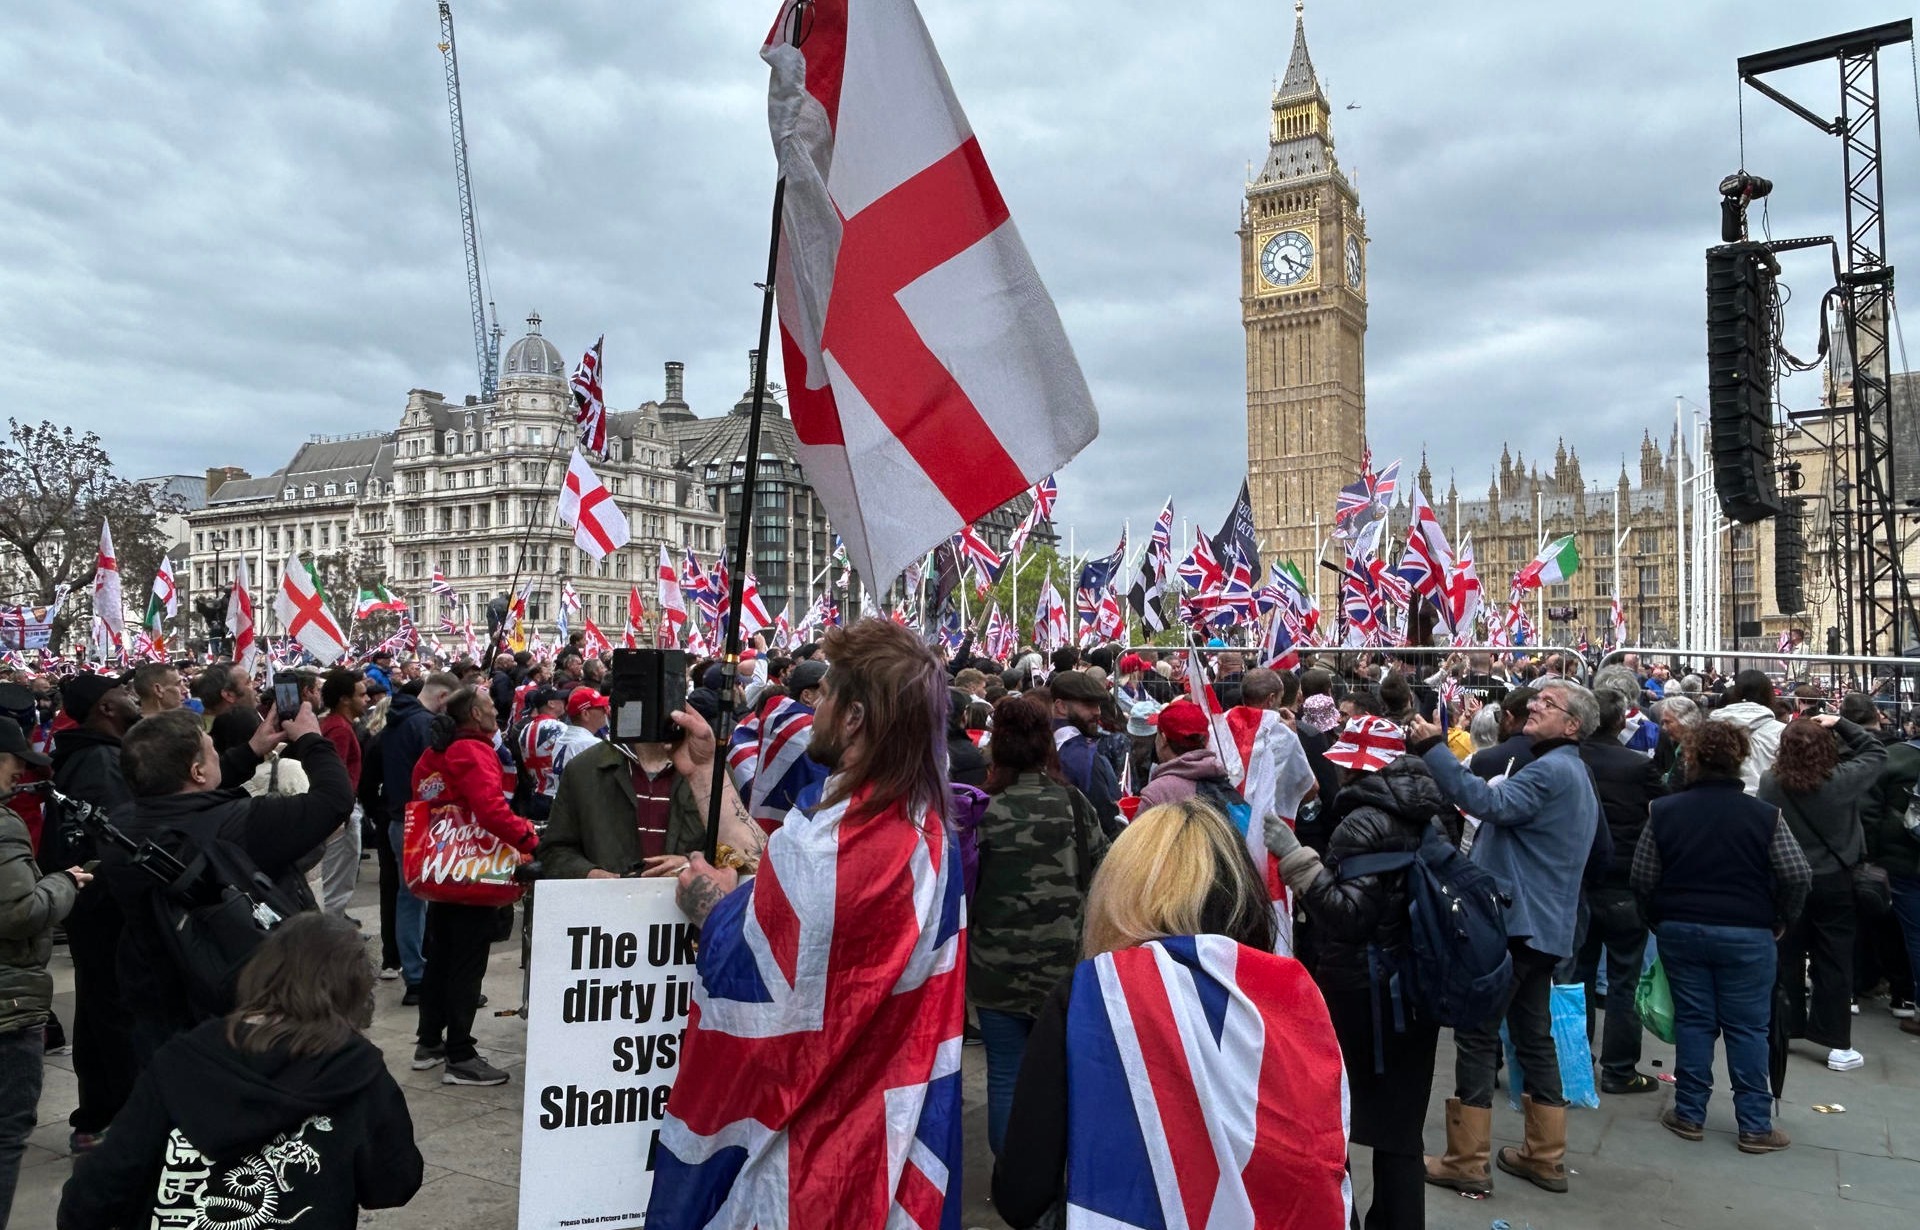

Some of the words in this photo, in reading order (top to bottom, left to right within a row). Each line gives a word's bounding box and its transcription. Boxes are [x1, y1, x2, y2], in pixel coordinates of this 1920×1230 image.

[459, 842, 478, 857] the
[567, 926, 638, 970] The
[562, 978, 657, 1024] dirty
[661, 974, 694, 1023] ju
[539, 1084, 672, 1130] Shame
